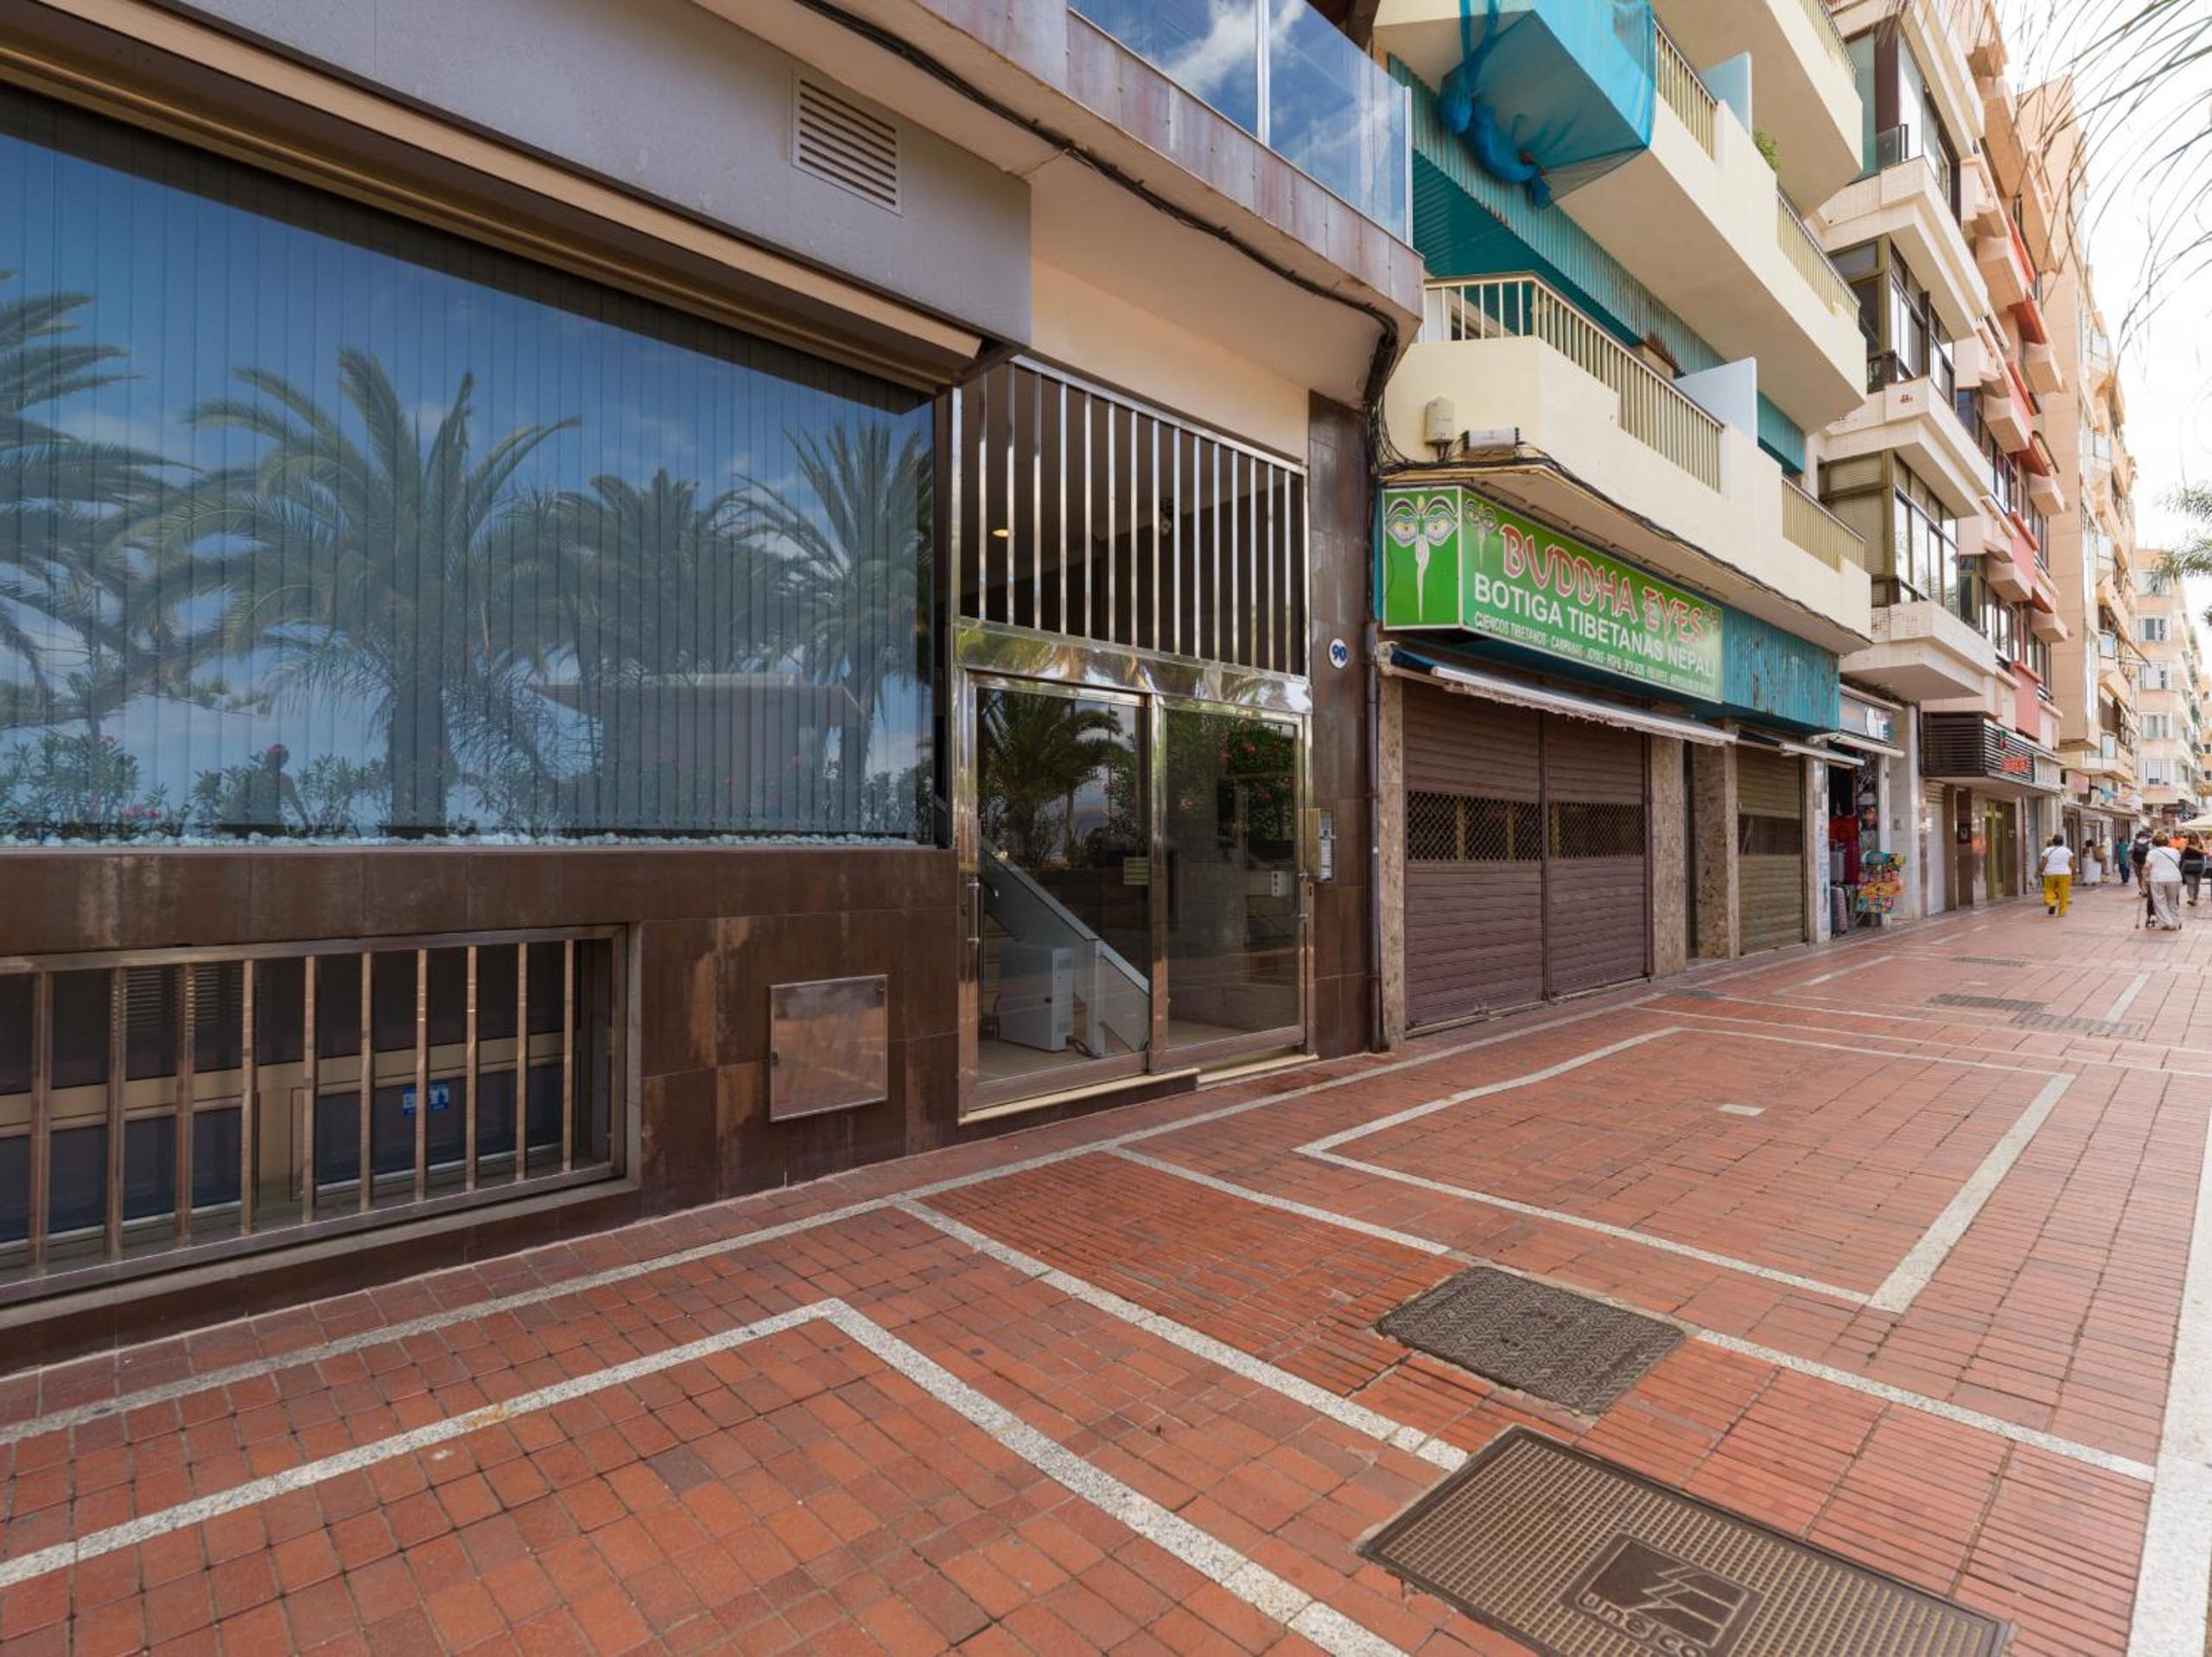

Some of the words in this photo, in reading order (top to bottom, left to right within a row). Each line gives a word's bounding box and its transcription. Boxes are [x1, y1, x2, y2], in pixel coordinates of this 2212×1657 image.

[1474, 573, 1563, 629] BOTIGA
[1567, 606, 1663, 662] TIBETANAS
[1500, 524, 1638, 624] BUDDHA
[1643, 586, 1705, 644] EYES
[1332, 644, 1347, 662] 90
